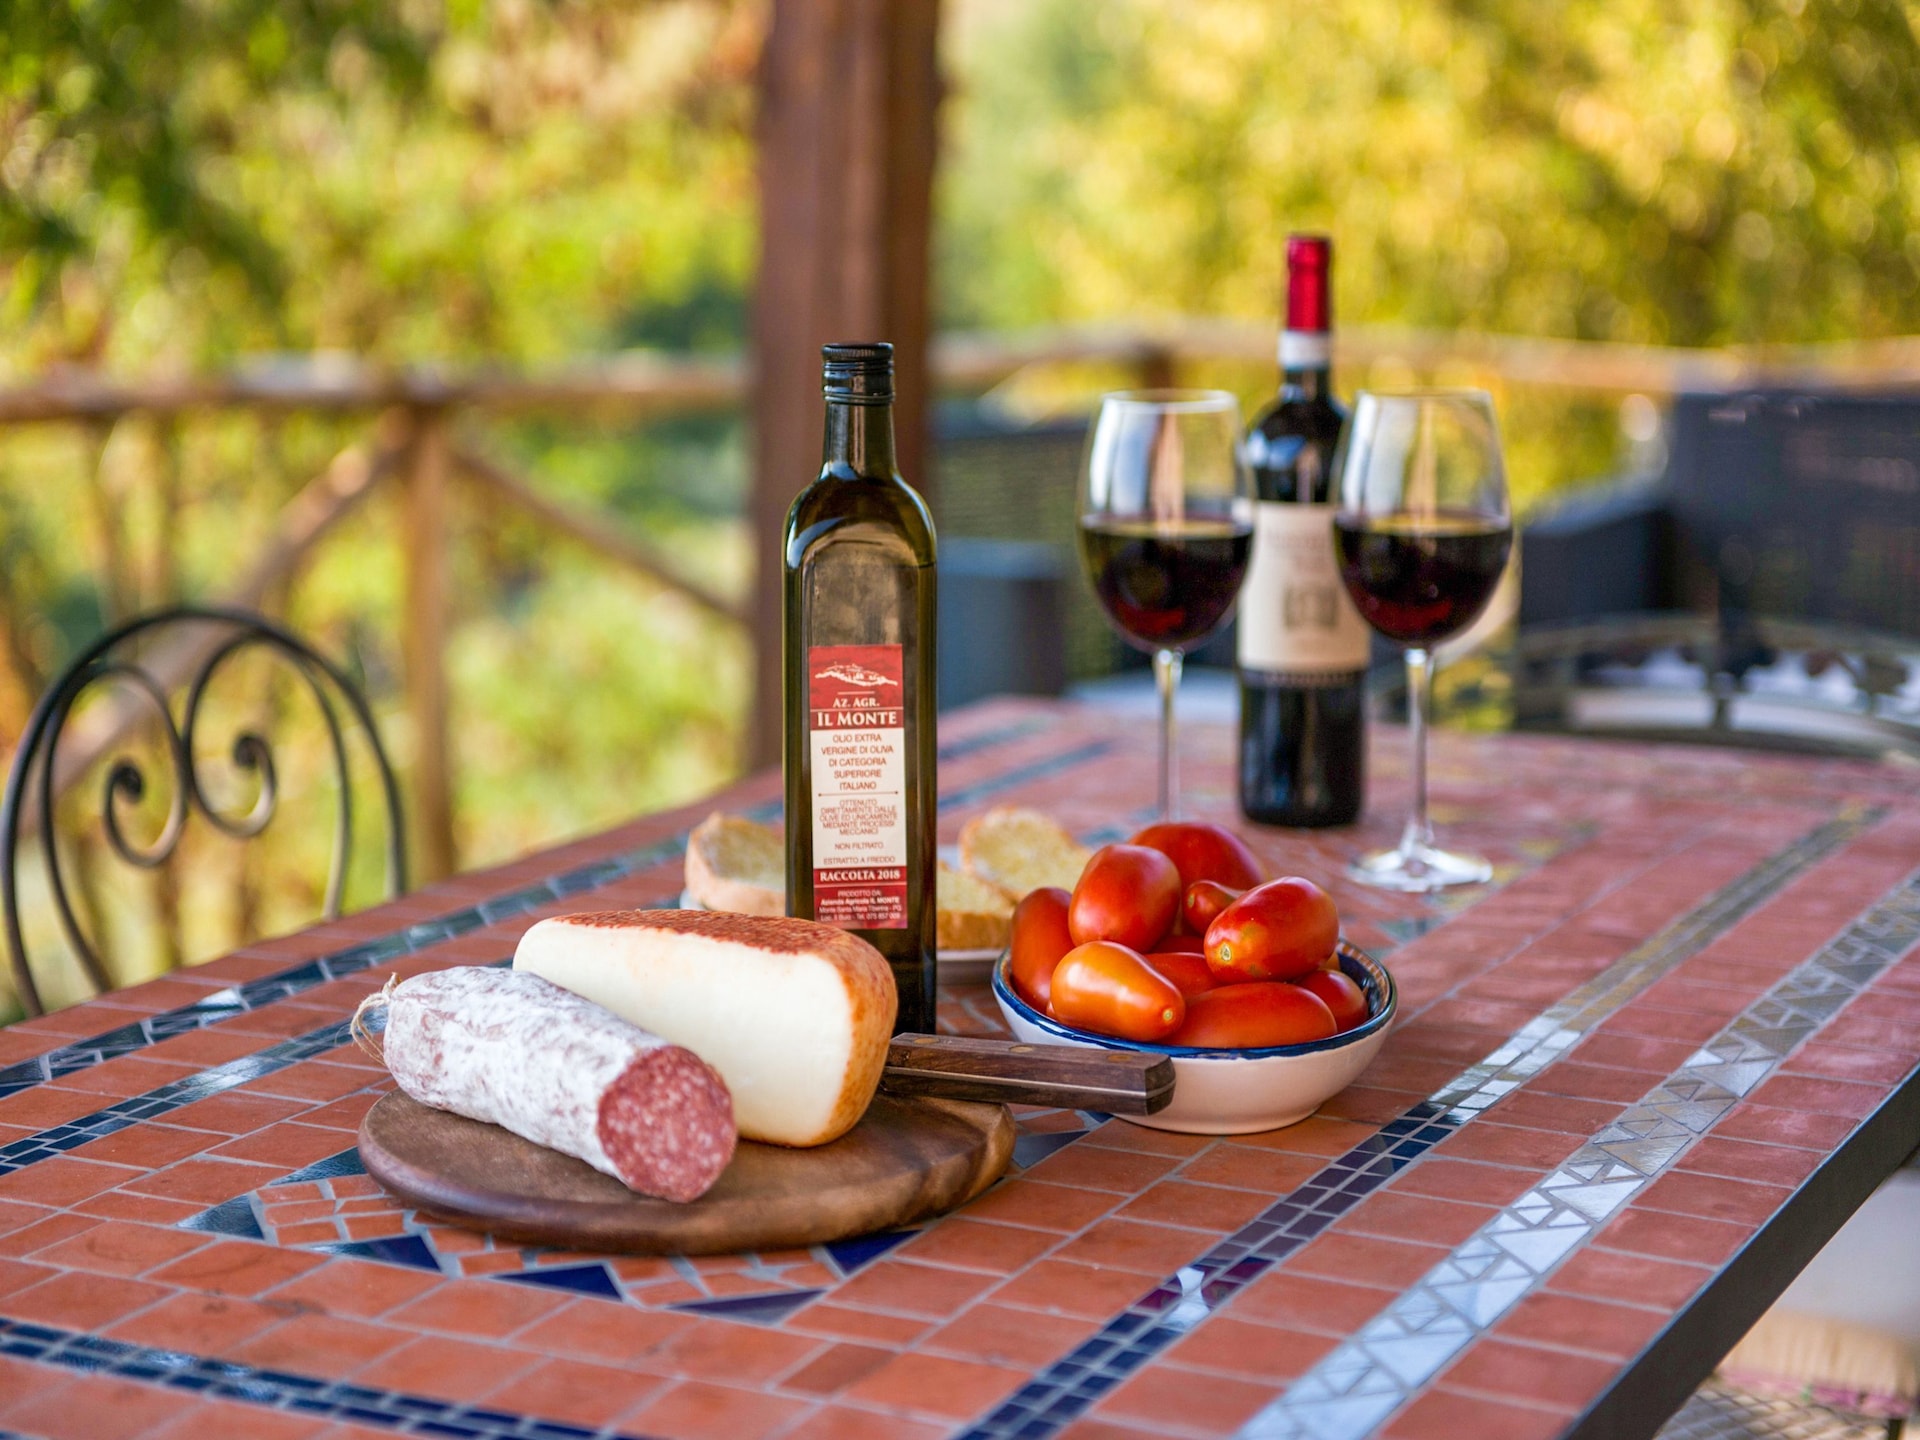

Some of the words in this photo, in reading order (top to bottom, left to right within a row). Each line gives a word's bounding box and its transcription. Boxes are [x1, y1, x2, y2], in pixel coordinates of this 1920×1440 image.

[833, 698, 851, 708] AZ.
[853, 698, 880, 708] AGR.
[817, 712, 833, 726] IL
[837, 711, 897, 726] MONTE
[832, 735, 853, 743] OLIO
[854, 733, 882, 742] EXTRA
[821, 747, 857, 755] VERGINE
[859, 746, 868, 754] DI
[869, 745, 894, 754] OLIVA
[828, 759, 837, 767] DI
[839, 757, 887, 767] CATEGORIA
[834, 770, 882, 779] SUPERIORE
[839, 781, 877, 790] ITALIANO
[839, 799, 877, 808] OTTENUTO
[874, 806, 896, 814] DALLE
[852, 842, 884, 850] FILTRATO
[823, 857, 859, 865] ESTRATTO
[867, 856, 896, 864] FREDDO
[820, 871, 875, 882] RACCOLTA
[877, 869, 900, 880] 2018
